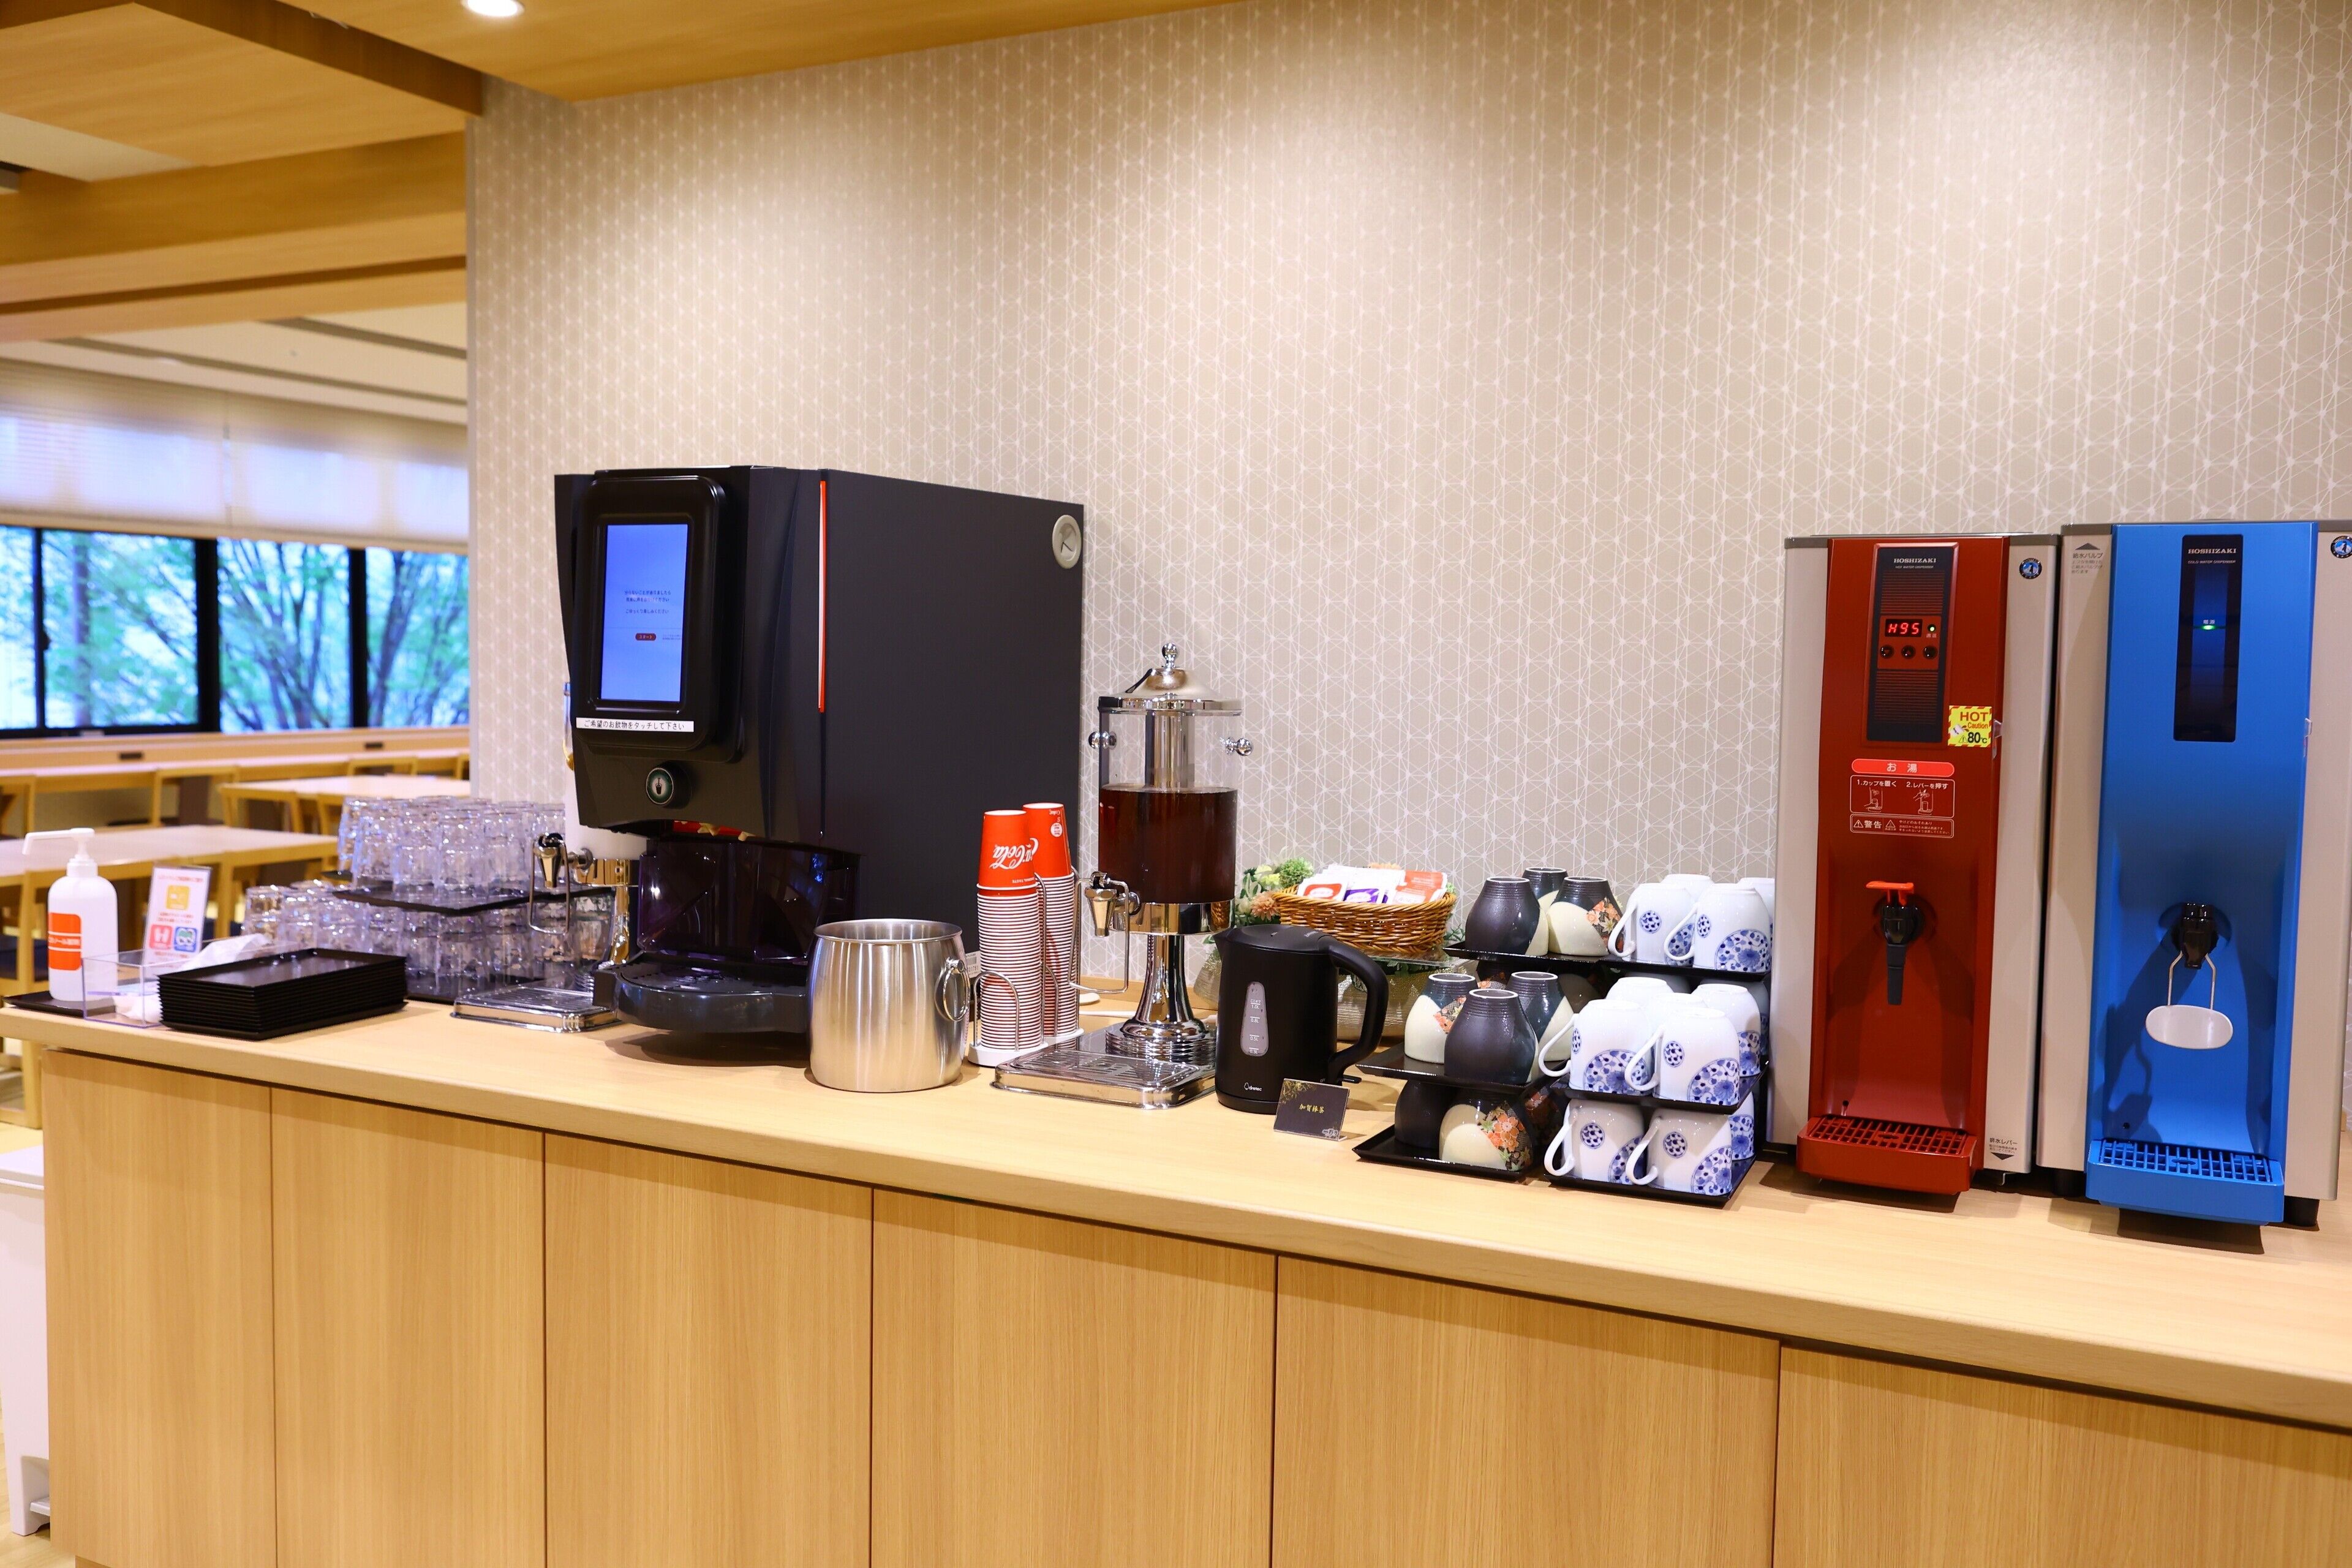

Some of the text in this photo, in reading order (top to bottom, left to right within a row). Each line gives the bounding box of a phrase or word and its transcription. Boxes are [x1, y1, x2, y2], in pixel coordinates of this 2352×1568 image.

[1960, 712, 1989, 722] HOT
[584, 720, 685, 730] ご希望のお飲物をタッチして下さい
[1864, 820, 1882, 829] 警告
